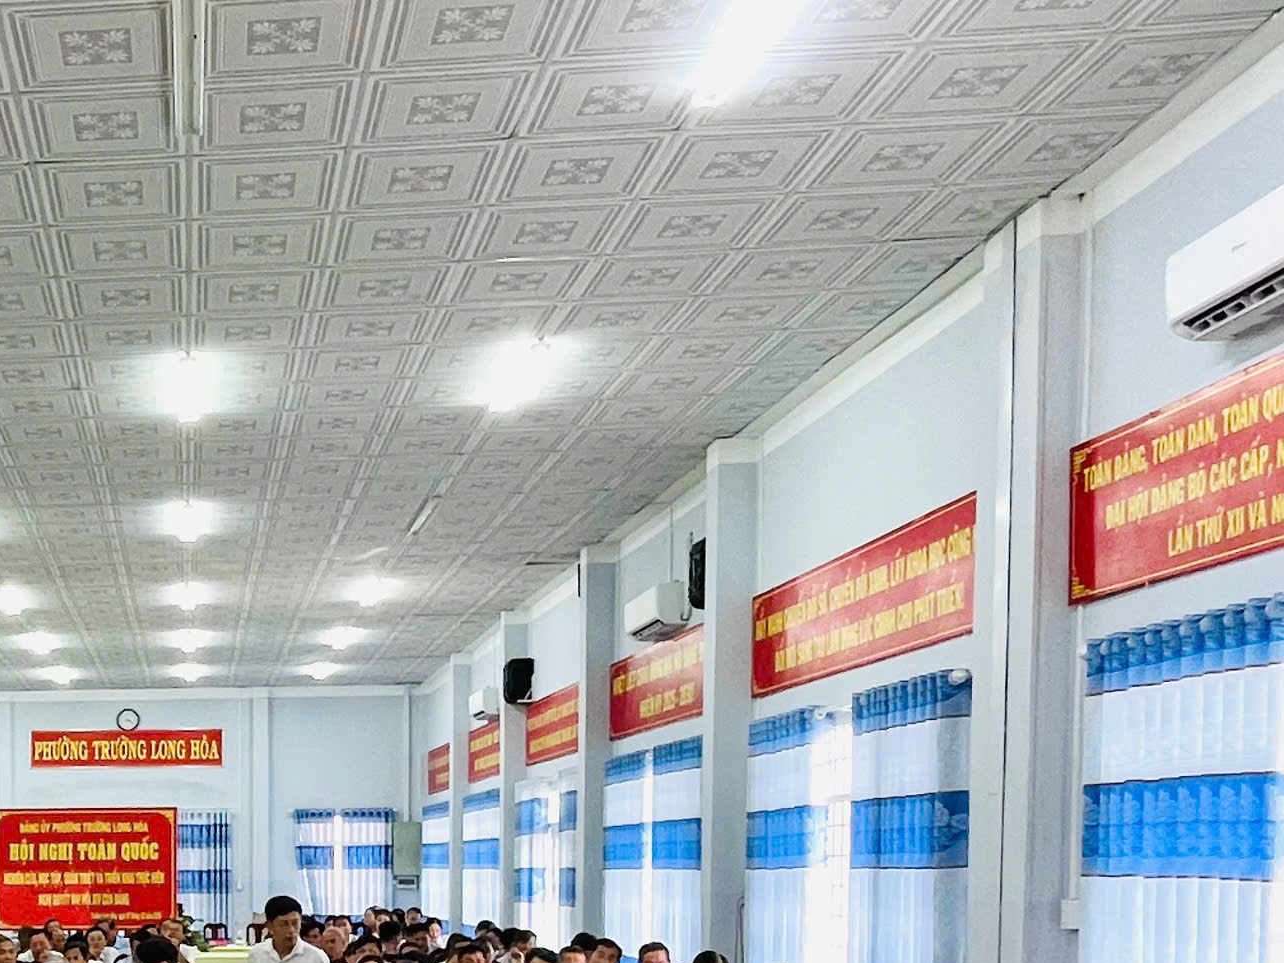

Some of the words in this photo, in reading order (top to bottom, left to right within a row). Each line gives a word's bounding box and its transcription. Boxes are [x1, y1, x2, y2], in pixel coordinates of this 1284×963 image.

[1209, 452, 1238, 493] CÁC
[1240, 434, 1273, 481] CẤP,
[1248, 491, 1268, 531] VÀ
[34, 735, 89, 761] PHƯỜNG
[92, 735, 147, 761] TRƯỜNG
[151, 740, 186, 760] LONG
[190, 734, 219, 760] HÒA
[9, 838, 34, 865] HỘI
[39, 842, 73, 865] NGHỊ
[77, 838, 116, 861] TOÀN
[121, 835, 159, 862] QUỐC
